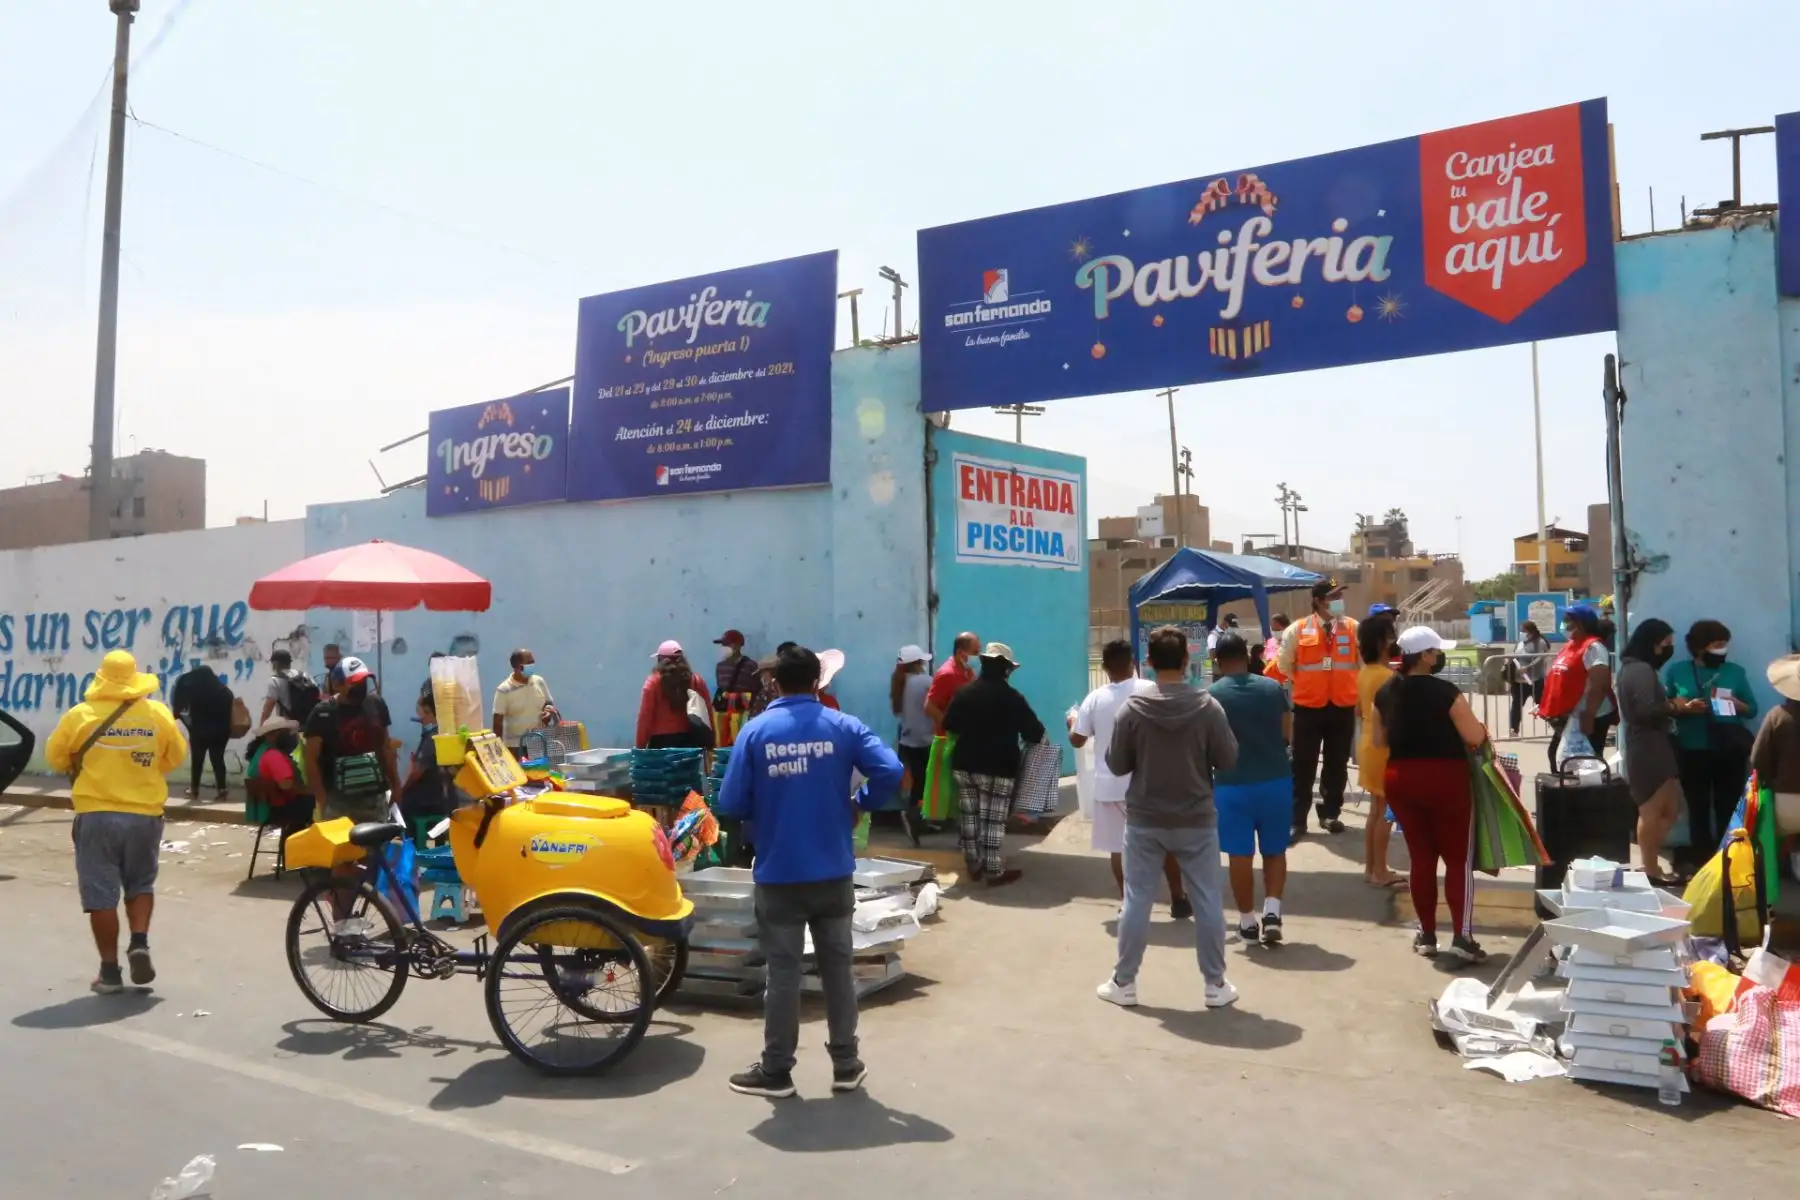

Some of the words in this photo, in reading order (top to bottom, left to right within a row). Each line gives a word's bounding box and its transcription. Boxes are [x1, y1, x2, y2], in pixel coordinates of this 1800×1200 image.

[1445, 142, 1556, 186] Canjea
[1450, 184, 1468, 199] tu
[1074, 215, 1394, 320] Paviferia
[1445, 212, 1563, 290] aquí
[616, 285, 772, 349] Paviferia
[642, 347, 694, 369] (Ingreso
[694, 340, 737, 363] puerta
[739, 335, 750, 353] 1)
[598, 386, 613, 399] Del
[625, 386, 632, 395] al
[645, 385, 651, 395] y
[651, 381, 661, 392] del
[676, 379, 684, 388] al
[699, 375, 708, 385] de
[708, 368, 755, 384] diciembre
[755, 367, 766, 377] del
[614, 423, 665, 441] Atención
[666, 424, 674, 435] el
[675, 418, 693, 434] 24
[694, 422, 703, 432] de
[705, 409, 770, 431] diciembre:
[436, 431, 554, 479] Ingreso
[960, 464, 1075, 515] ENTRADA
[1010, 508, 1018, 526] A
[1020, 510, 1034, 528] LA
[967, 521, 1065, 558] PISCINA
[25, 611, 71, 653] un
[82, 606, 153, 650] ser
[161, 600, 248, 674] que
[764, 740, 834, 759] Recarga
